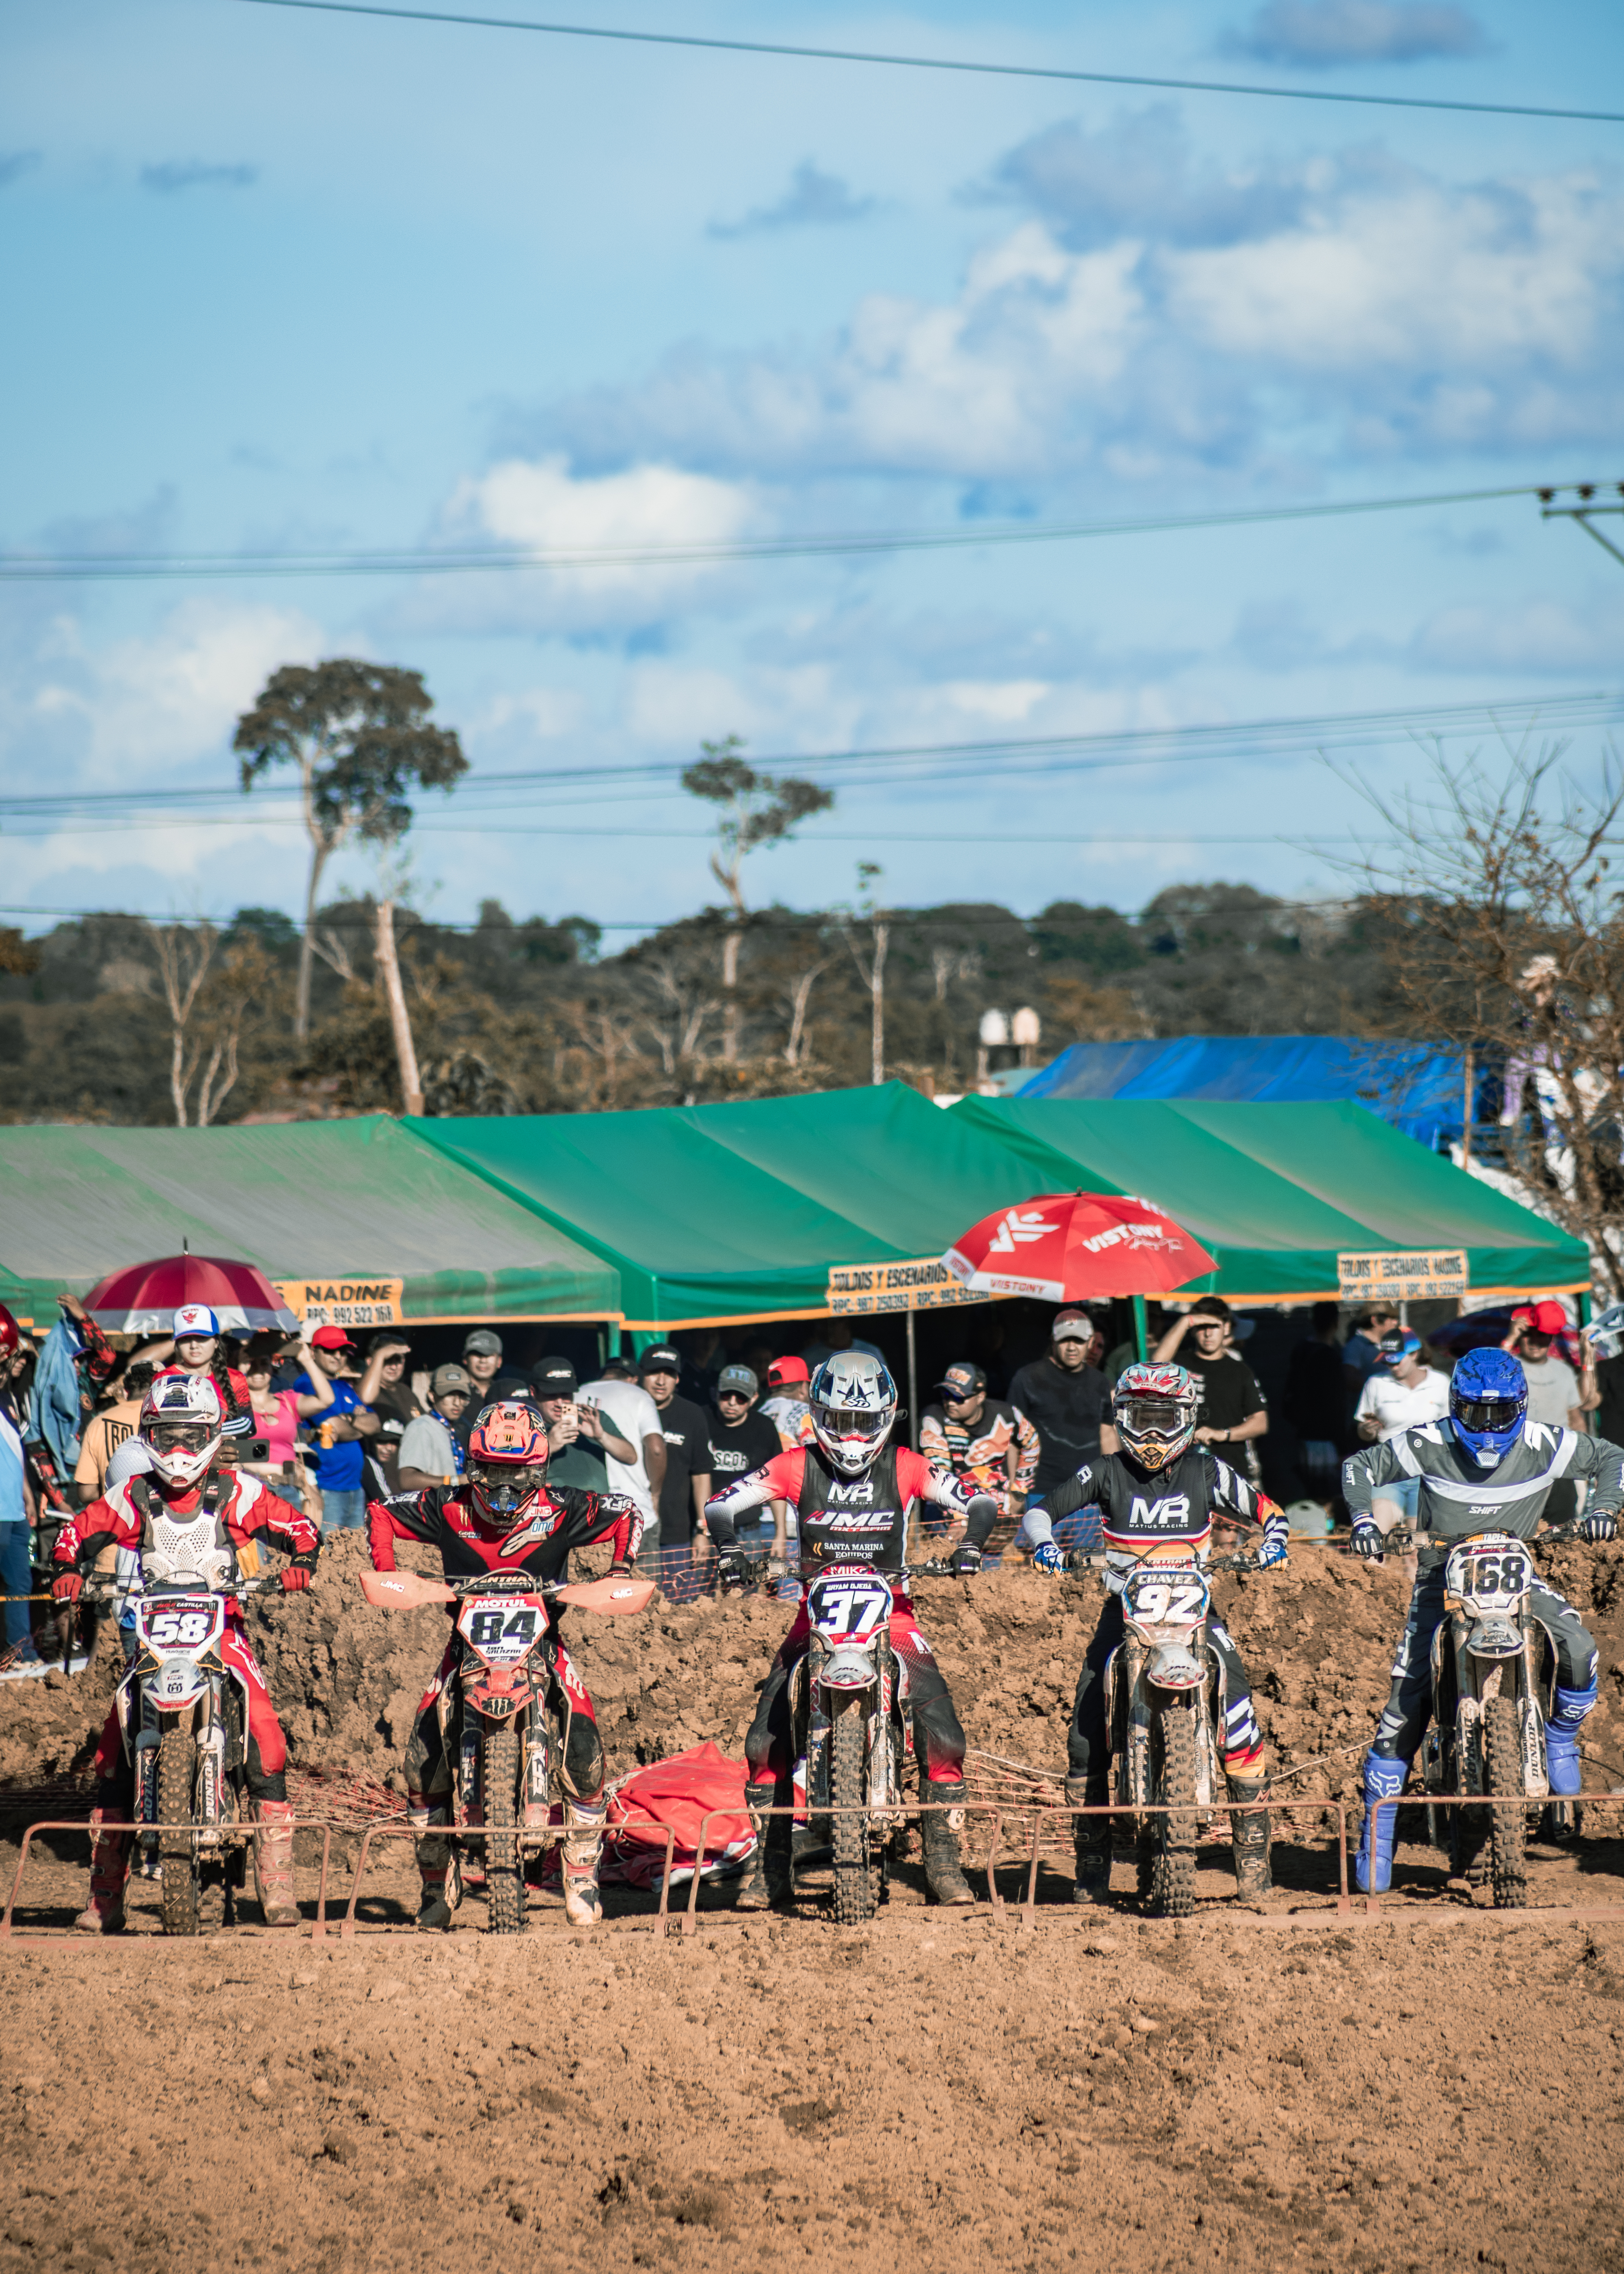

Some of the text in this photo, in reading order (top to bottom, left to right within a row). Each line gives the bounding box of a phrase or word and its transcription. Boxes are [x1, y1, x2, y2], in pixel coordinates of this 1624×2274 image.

[1082, 1223, 1163, 1253] VISTONY
[887, 1262, 947, 1288] ESCENARIOS
[306, 1285, 392, 1301] NADINE
[990, 1279, 1047, 1293] VISTONY
[334, 1307, 352, 1323] 992
[354, 1306, 373, 1323] 522
[1346, 1464, 1356, 1486] SHIFT
[827, 1481, 873, 1502] MR
[1129, 1494, 1190, 1524] MR
[1469, 1506, 1502, 1514] SHIFT
[532, 1522, 555, 1533] DMG
[806, 1511, 895, 1527] JMC
[824, 1542, 850, 1550] SANTA
[1138, 1574, 1194, 1584] CHAVEZ
[1459, 1556, 1525, 1597] 168
[380, 1580, 405, 1593] JMC
[610, 1588, 633, 1599] JMC
[475, 1599, 527, 1608] MOTUL
[818, 1591, 887, 1635] 37
[1133, 1585, 1204, 1624] 92
[149, 1613, 209, 1645] 58
[470, 1611, 536, 1645] 84
[1528, 1722, 1539, 1779] DUNLOP
